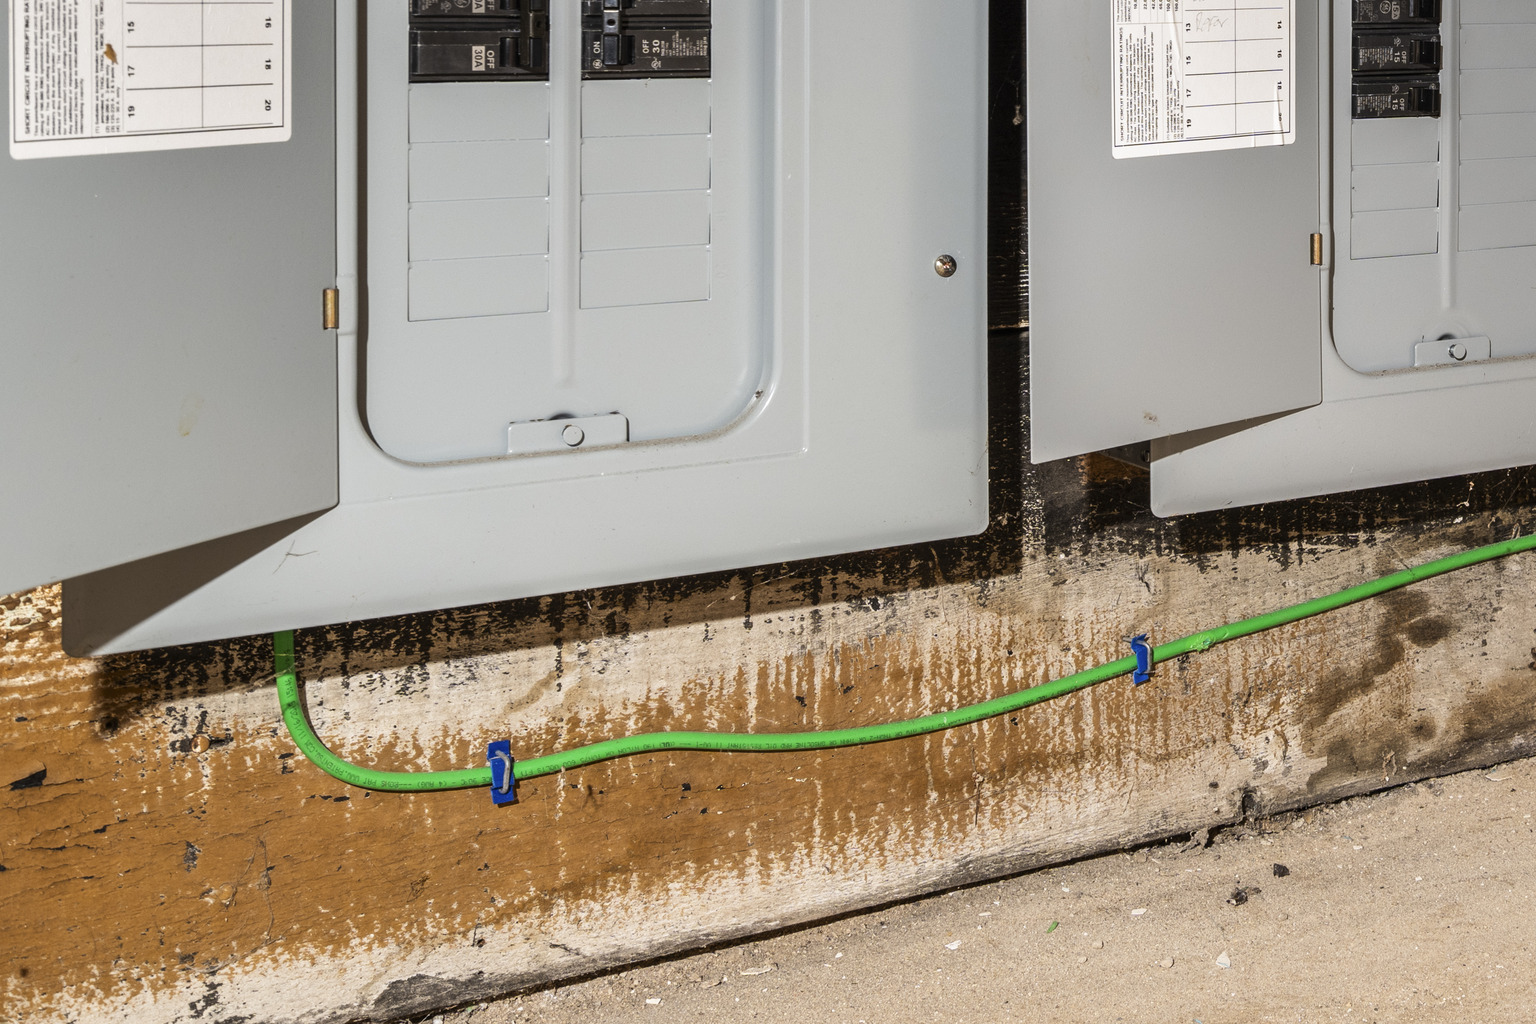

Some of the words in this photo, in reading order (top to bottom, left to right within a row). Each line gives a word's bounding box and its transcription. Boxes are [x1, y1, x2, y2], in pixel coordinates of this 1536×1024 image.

[594, 41, 600, 54] ON
[652, 40, 660, 54] 30
[474, 47, 484, 69] 30A
[1394, 51, 1400, 63] 15
[1392, 98, 1398, 111] 15
